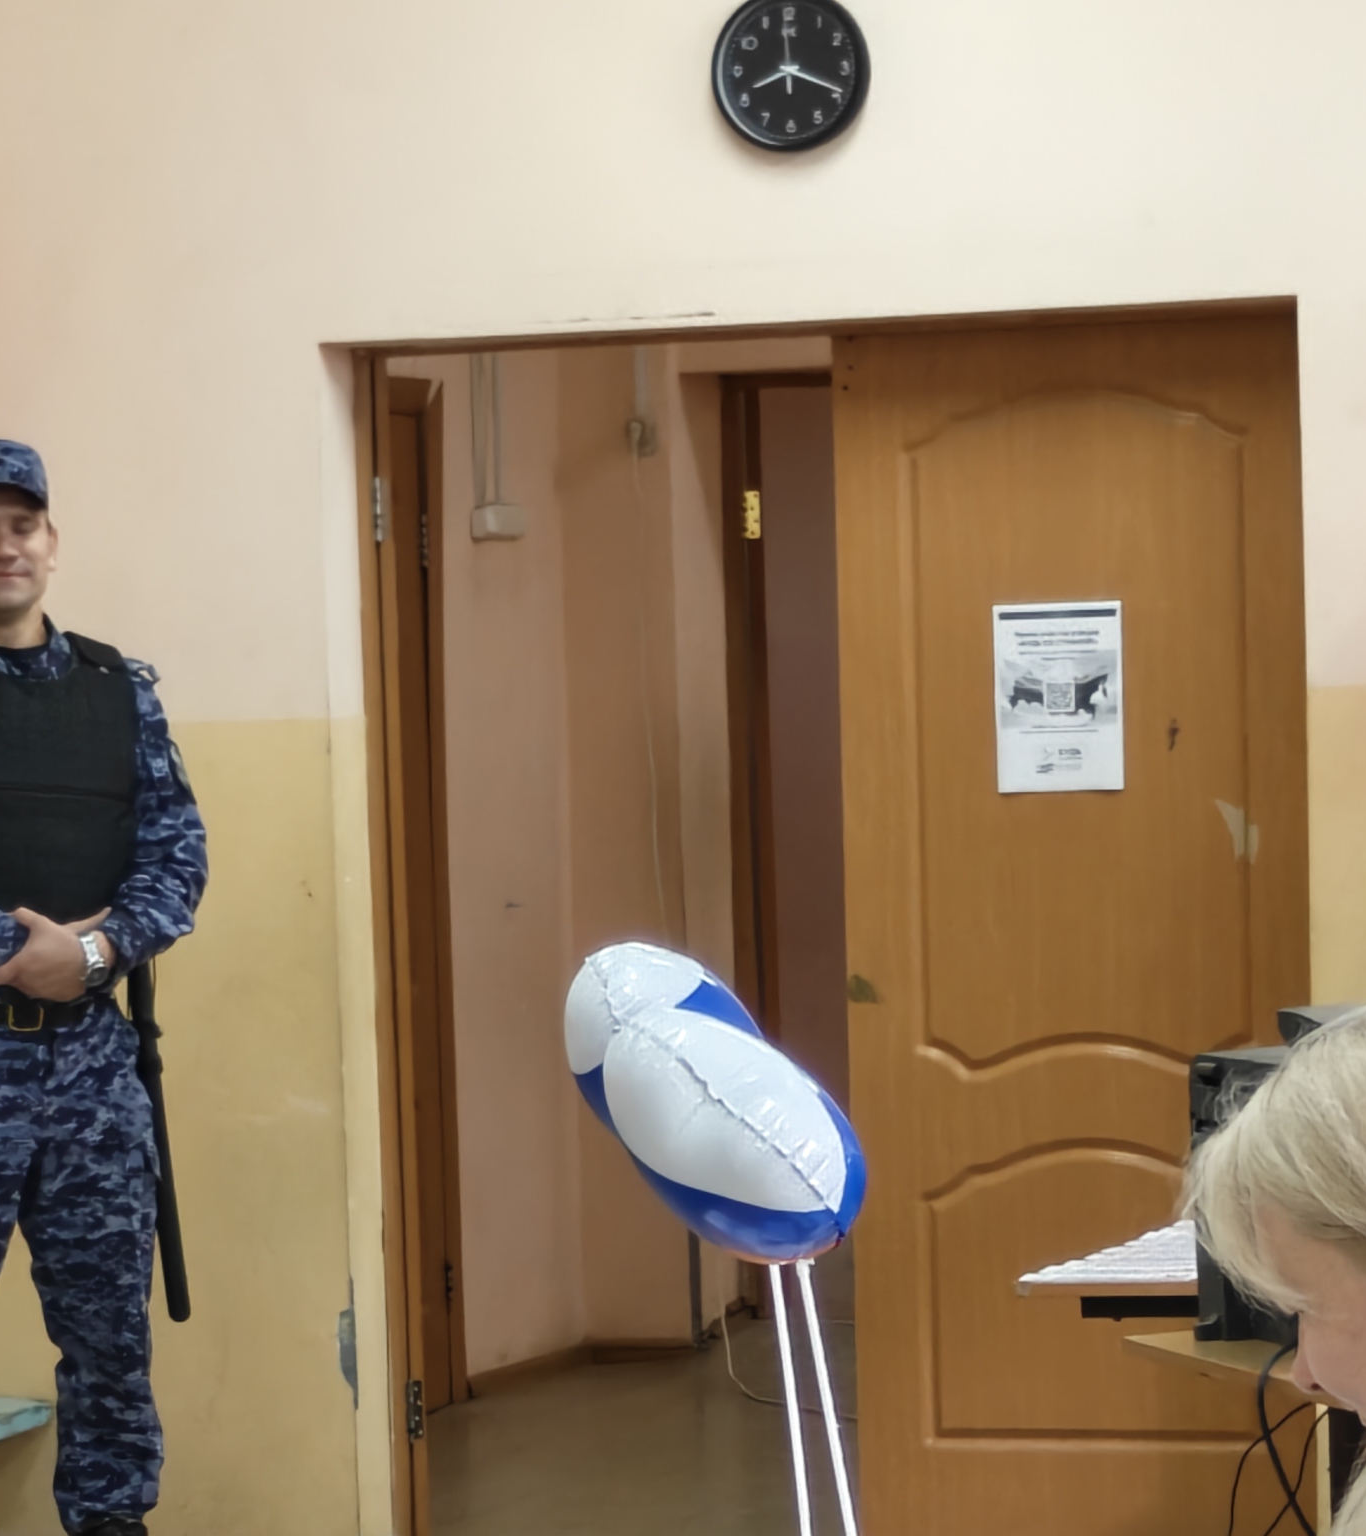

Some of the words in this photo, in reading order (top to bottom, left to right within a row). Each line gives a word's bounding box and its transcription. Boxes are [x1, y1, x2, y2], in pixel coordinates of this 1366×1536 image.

[831, 32, 842, 46] 2
[839, 60, 851, 76] 3
[760, 112, 770, 127] 7
[813, 110, 823, 125] 5
